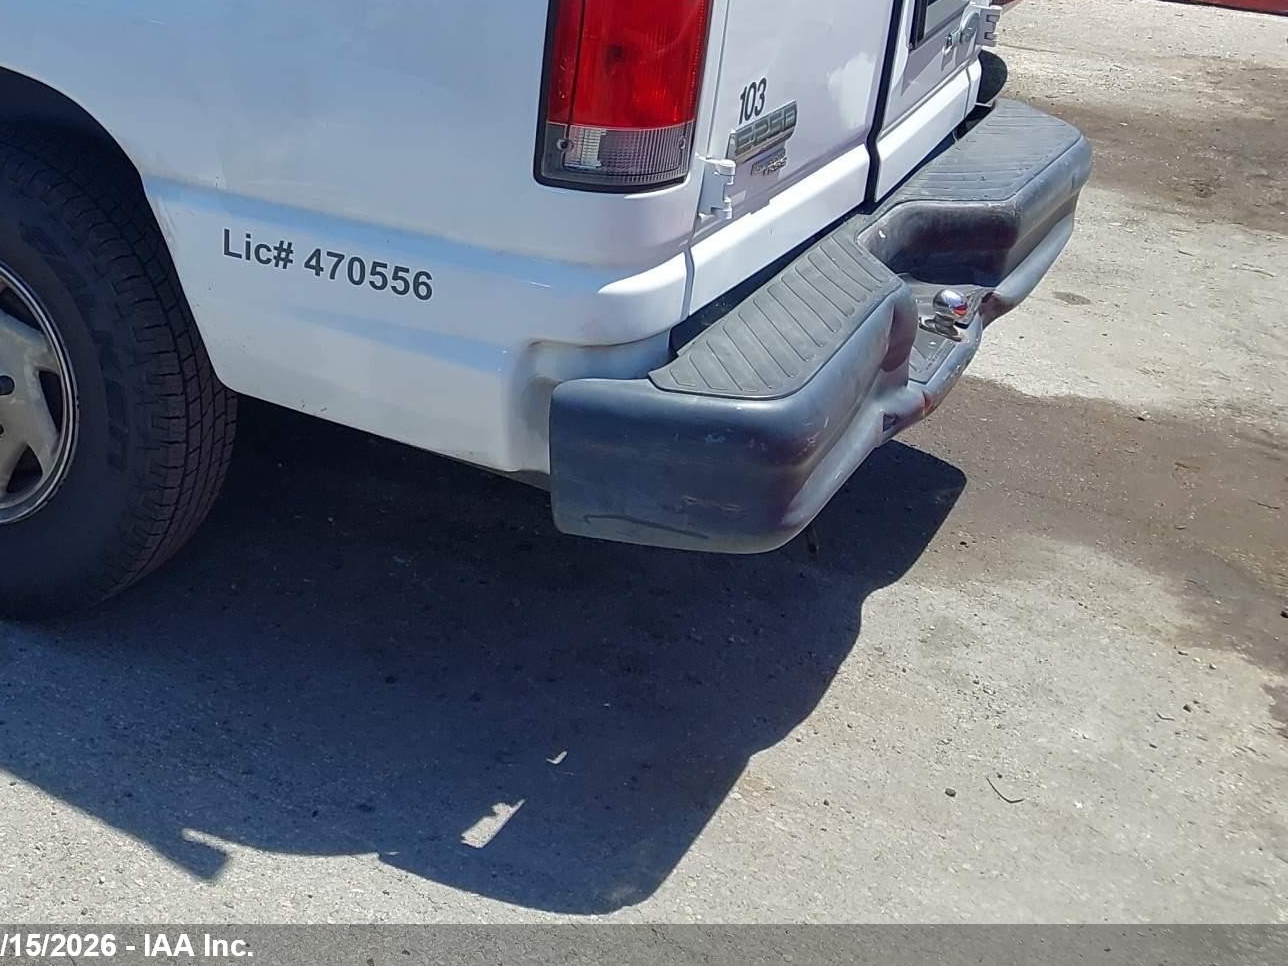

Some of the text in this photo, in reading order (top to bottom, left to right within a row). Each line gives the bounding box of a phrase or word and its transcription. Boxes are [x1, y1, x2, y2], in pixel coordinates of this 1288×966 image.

[738, 77, 768, 125] 103
[223, 228, 433, 301] Lic# 470556
